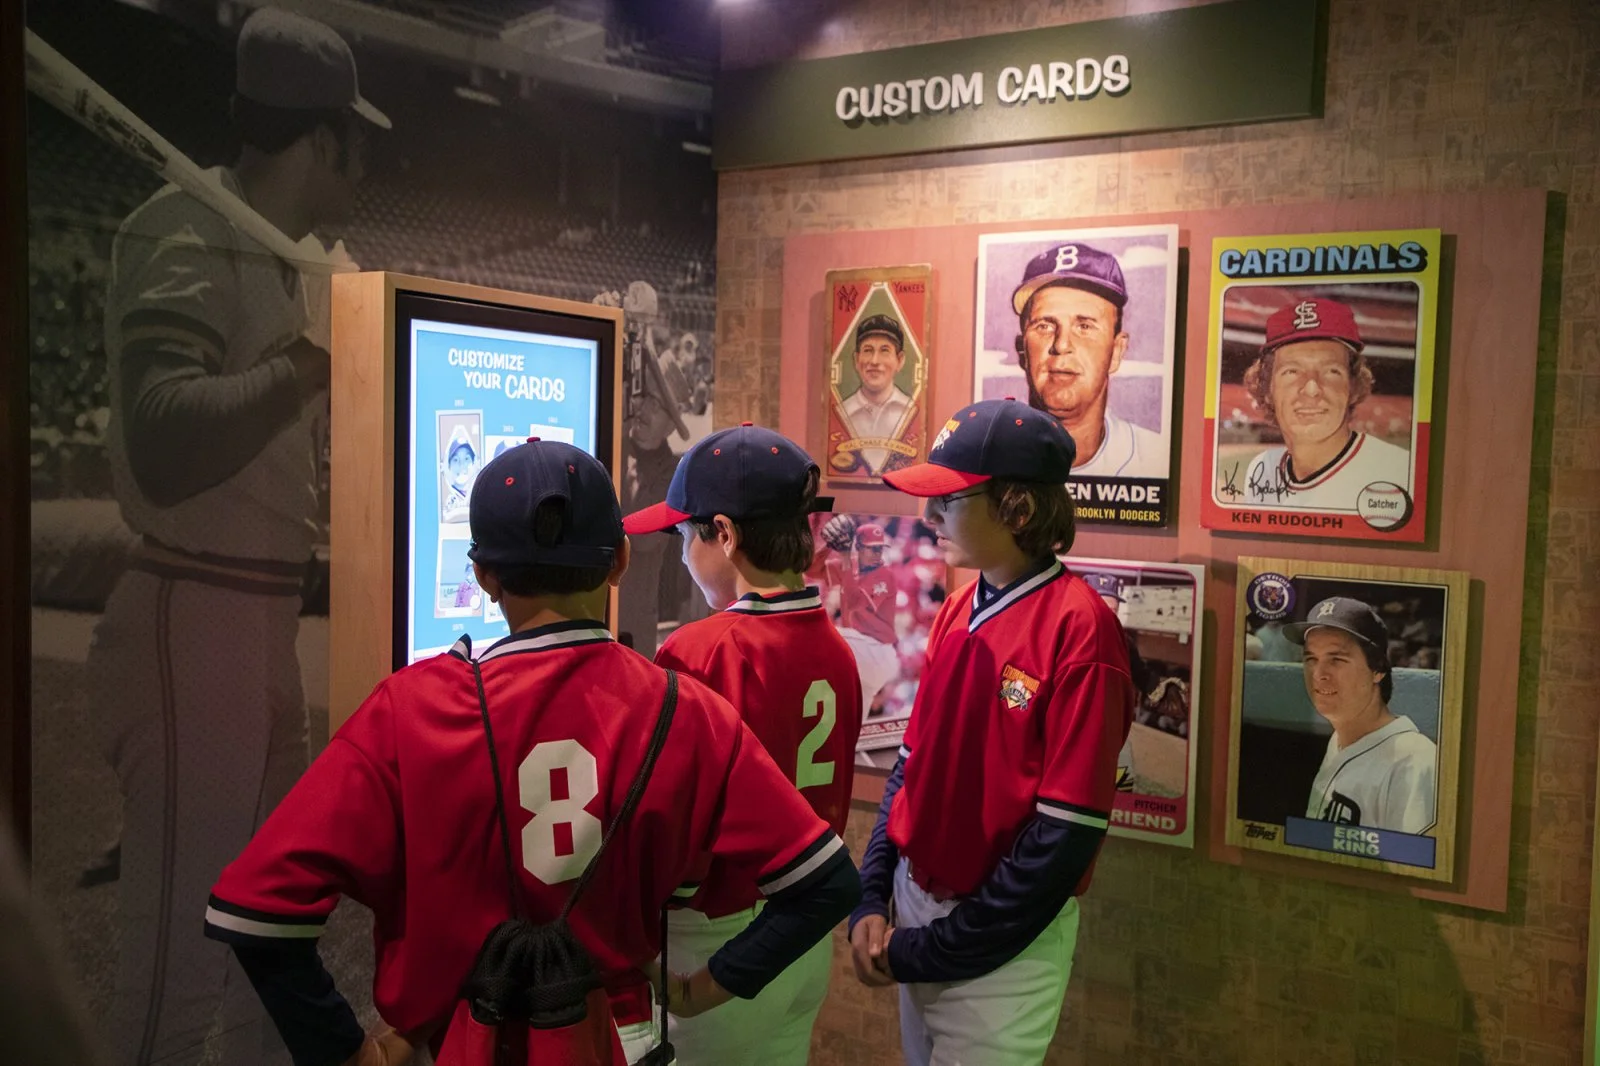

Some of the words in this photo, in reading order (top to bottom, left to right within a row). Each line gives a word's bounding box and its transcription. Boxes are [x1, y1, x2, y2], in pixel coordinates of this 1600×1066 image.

[836, 72, 983, 120] CUSTOM
[998, 55, 1130, 103] CARDS
[1052, 245, 1079, 274] B
[1220, 242, 1427, 277] CARDINALS
[448, 348, 524, 371] CUSTOMIZE
[464, 371, 501, 389] YOUR
[505, 374, 565, 402] CARDS
[1064, 482, 1091, 500] EN
[1096, 484, 1160, 503] WADE
[1368, 498, 1398, 509] Catcher
[1120, 509, 1160, 521] DODGERS
[1232, 512, 1261, 524] KEN
[1268, 514, 1343, 529] RUDOLPH
[796, 679, 836, 790] 2
[518, 738, 602, 885] 8
[1134, 800, 1177, 813] PITCHER
[1110, 809, 1176, 831] RIEND
[1333, 826, 1380, 844] ERIC
[1332, 839, 1380, 855] KING
